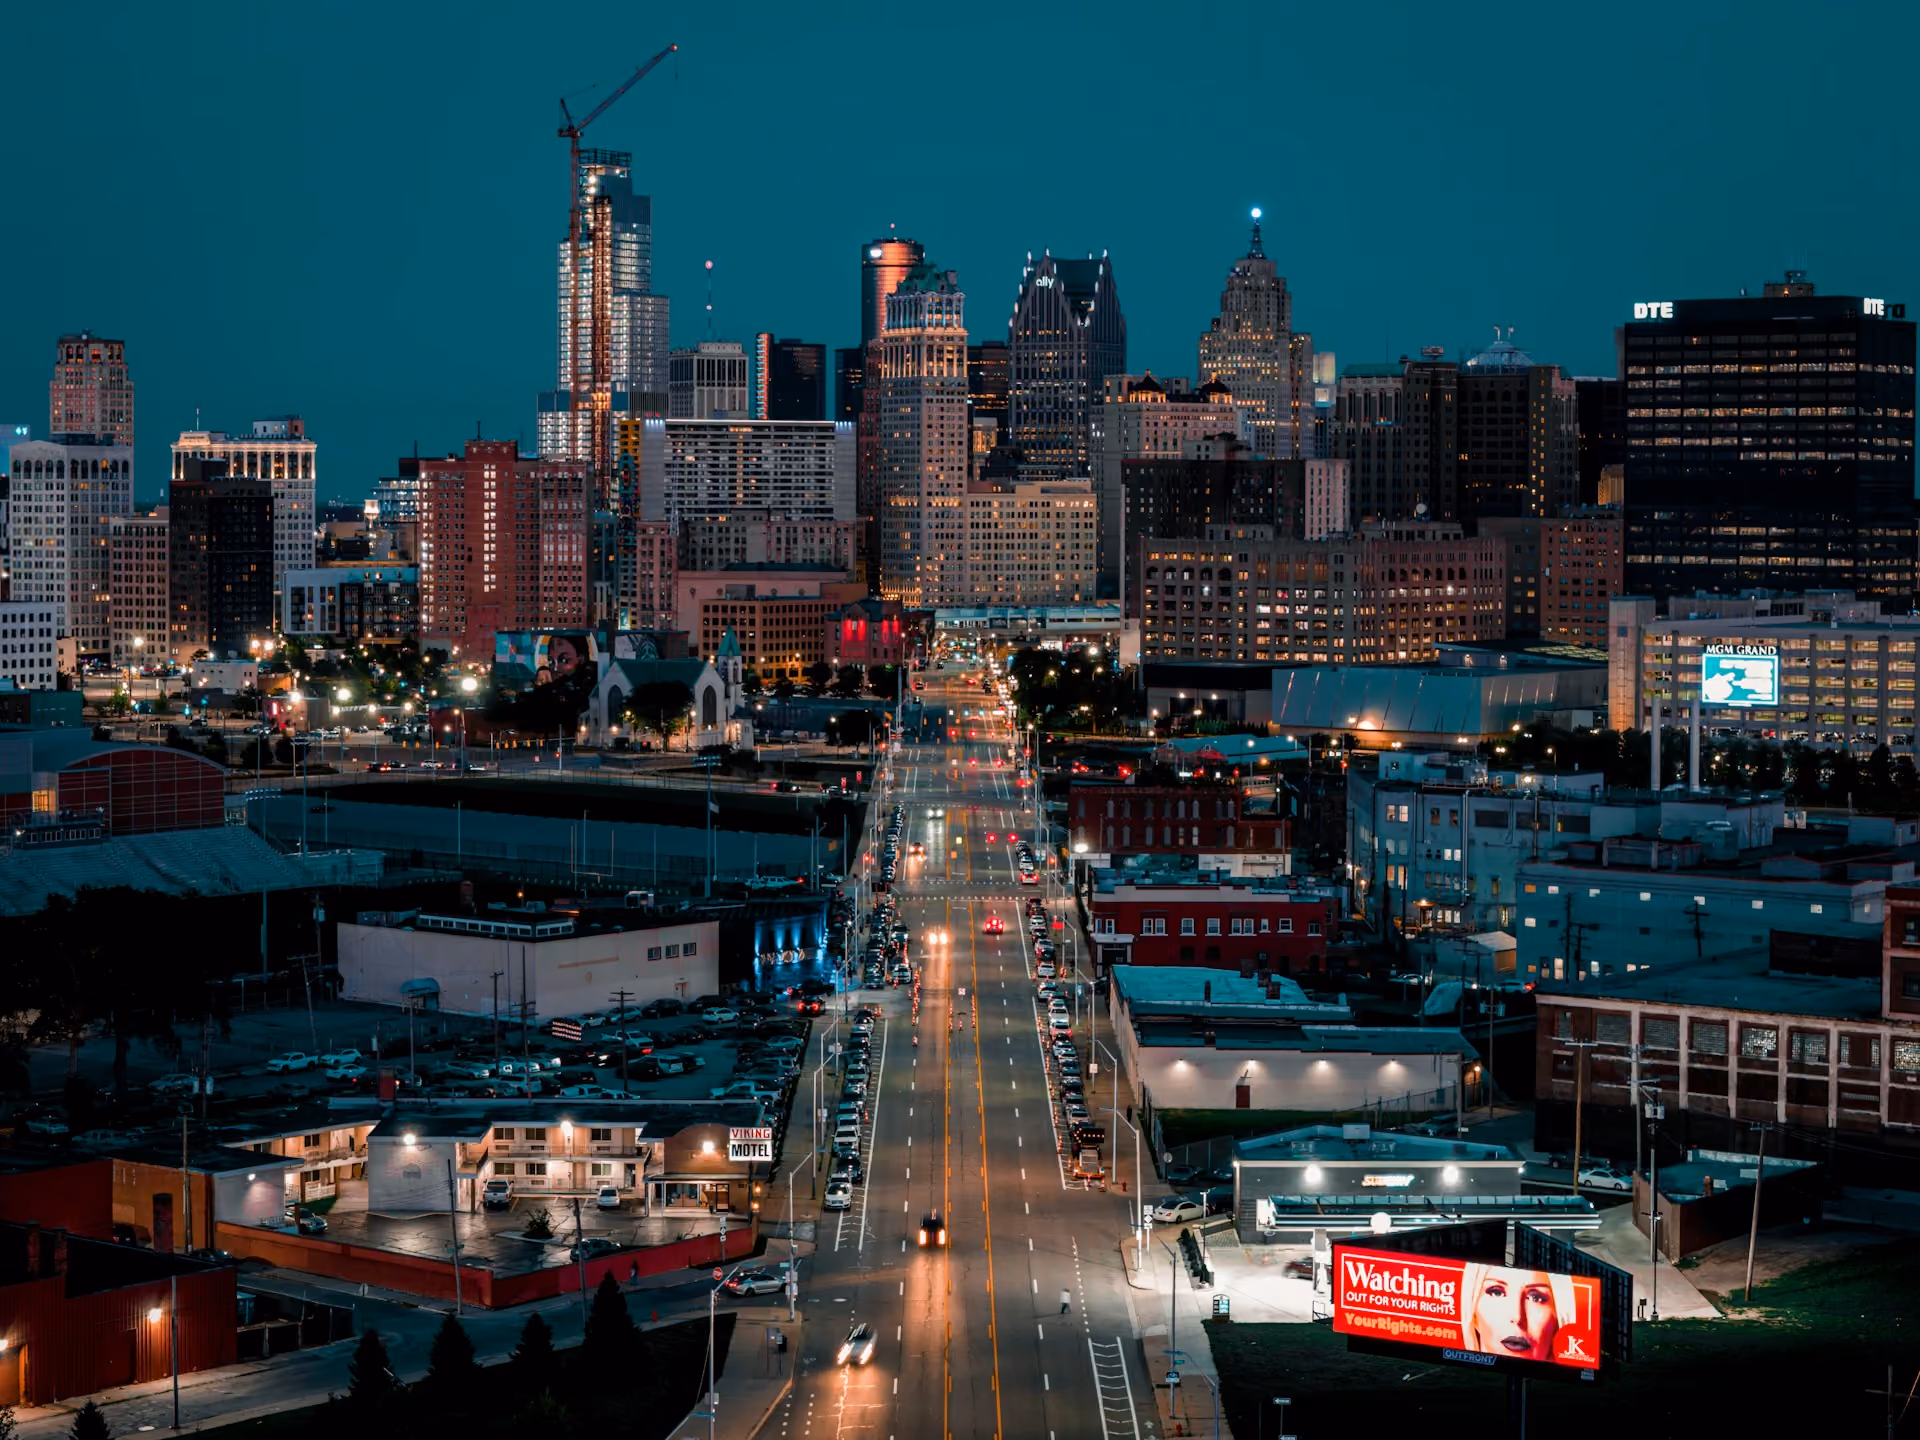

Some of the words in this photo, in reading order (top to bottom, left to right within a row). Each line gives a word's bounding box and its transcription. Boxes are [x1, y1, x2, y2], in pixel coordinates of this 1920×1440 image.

[1036, 276, 1054, 289] ally
[1634, 302, 1673, 319] DTE
[1863, 297, 1884, 316] DTE
[1706, 645, 1733, 655] MGM
[1736, 645, 1777, 655] GRAND
[731, 1128, 770, 1139] VIKING
[731, 1143, 770, 1157] MOTEL
[1361, 1174, 1414, 1186] SUBY
[1344, 1261, 1456, 1307] Watching
[1346, 1291, 1367, 1303] OUT
[1369, 1294, 1389, 1306] FOR
[1390, 1297, 1418, 1311] YOUR
[1420, 1301, 1456, 1316] RIGHTS
[1344, 1312, 1457, 1340] YourRights.com
[1564, 1335, 1586, 1355] JK
[1444, 1350, 1494, 1364] OUTFRONT
